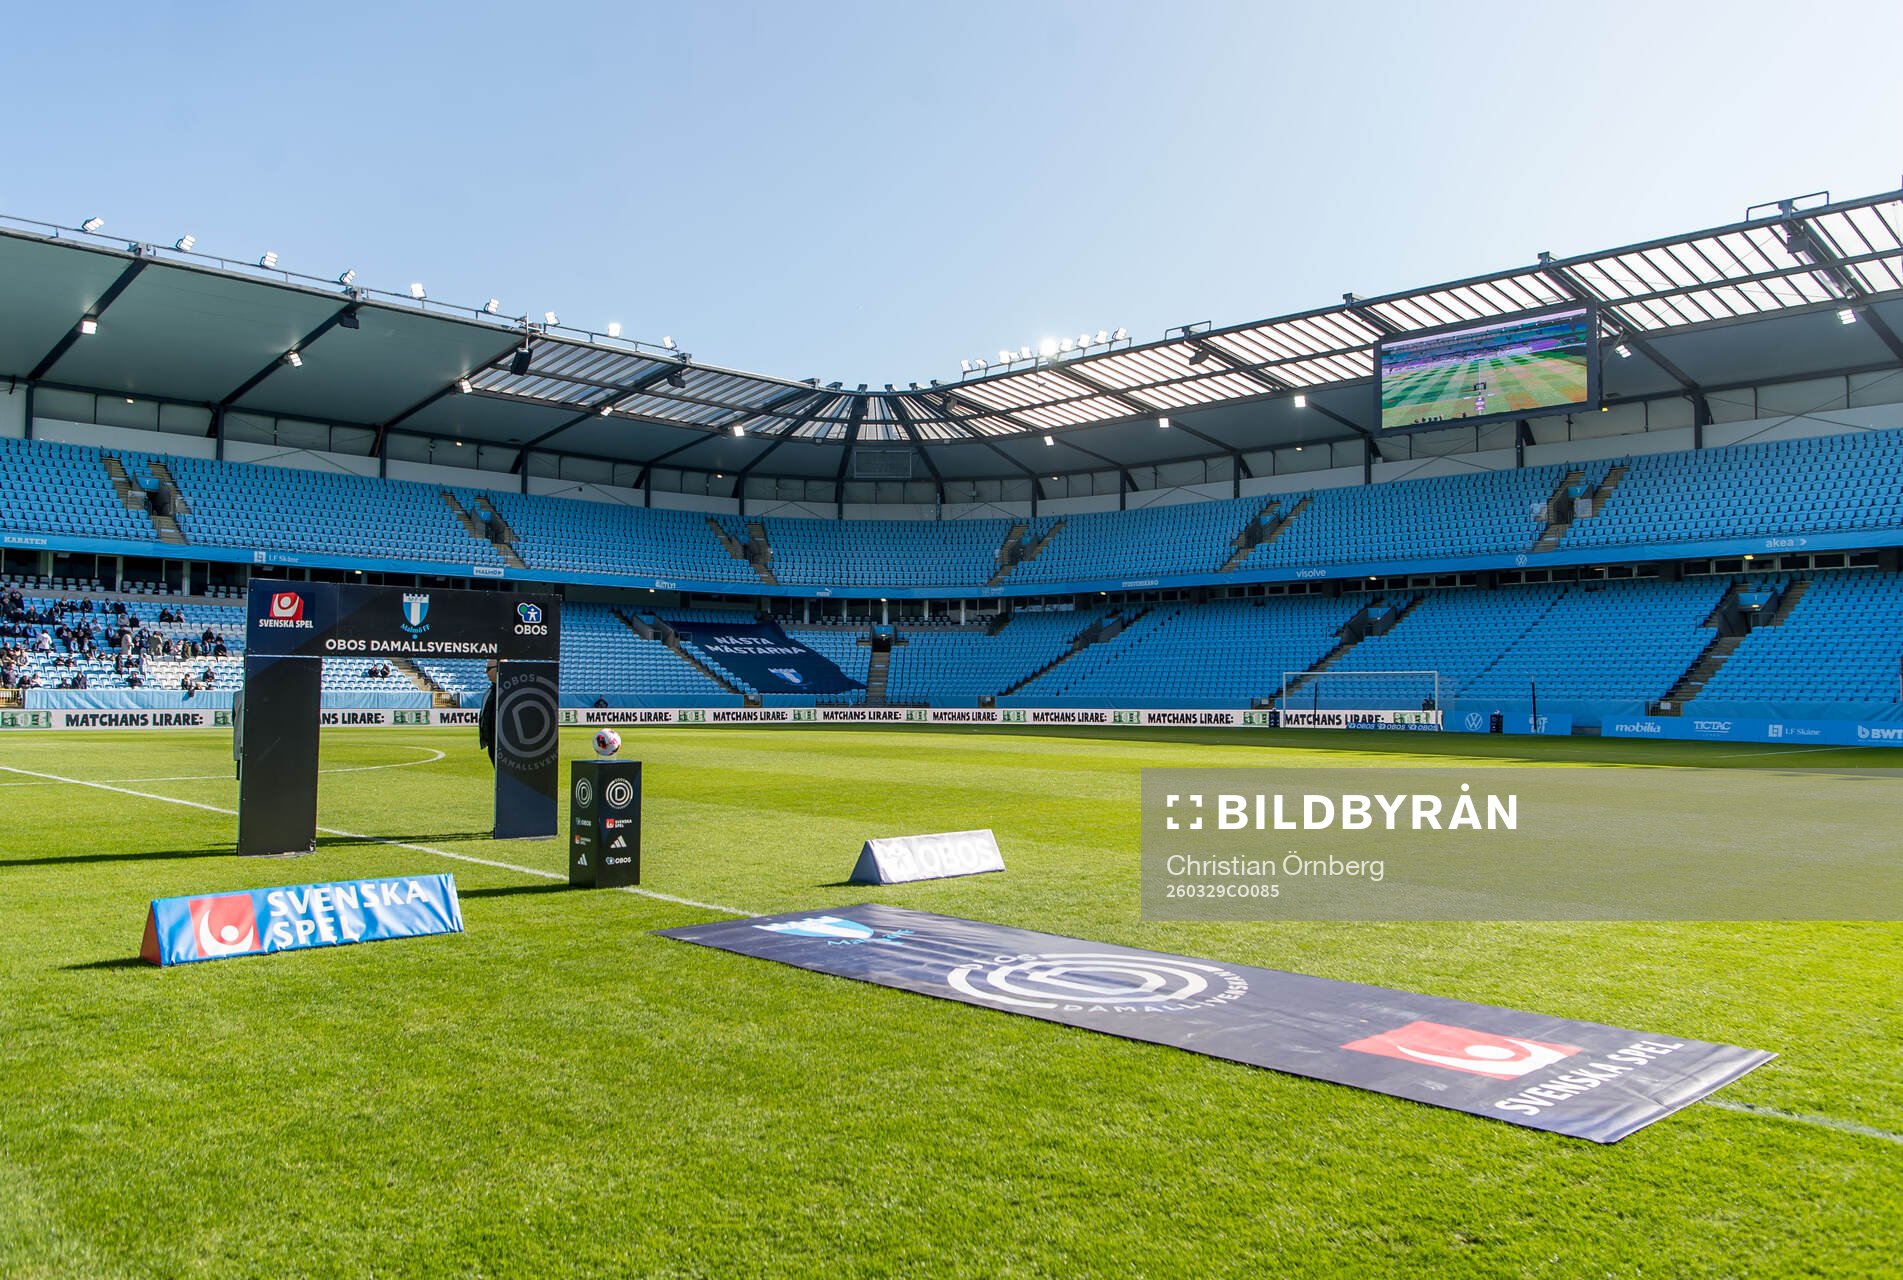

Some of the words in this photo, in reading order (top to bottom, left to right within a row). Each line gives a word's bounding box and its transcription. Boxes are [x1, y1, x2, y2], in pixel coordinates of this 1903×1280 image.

[1765, 538, 1794, 547] akea
[1296, 568, 1326, 577] visolve
[259, 619, 294, 628] SVENSKA
[296, 620, 314, 629] SPEL
[400, 623, 423, 634] Malmö
[422, 624, 432, 632] FF
[514, 624, 548, 636] OBOS
[713, 635, 775, 645] NÄSTA
[326, 638, 366, 652] OBOS
[370, 639, 498, 654] DAMALLSVENSKAN
[704, 643, 807, 654] MÄSTARNA
[503, 673, 536, 690] OBOS
[65, 713, 149, 727] MATCHANS
[152, 713, 204, 726] LIRARE:
[341, 712, 385, 724] LIRARE:
[440, 713, 479, 724] MATCH
[586, 711, 638, 722] MATCHANS
[639, 711, 672, 722] LIRARE:
[713, 711, 758, 721] MATCHANS
[760, 711, 788, 720] LIRARE:
[822, 711, 867, 720] MATCHANS
[868, 711, 902, 720] LIRARE:
[932, 711, 970, 721] MATCHANS
[972, 711, 998, 721] LIRARE:
[1032, 712, 1076, 722] MATCHANS
[1077, 712, 1107, 722] LIRARE:
[1147, 713, 1198, 724] MATCHANS
[1199, 713, 1234, 724] LIRARE:
[1285, 713, 1342, 726] MATCHANS
[1615, 722, 1661, 733] mobilia
[1693, 721, 1732, 730] TICTAC
[918, 837, 995, 873] OBOS
[267, 880, 430, 917] SVENSKA
[272, 916, 363, 949] SPEL
[1494, 1061, 1635, 1117] SVENSKA
[1629, 1039, 1686, 1071] SPEL
